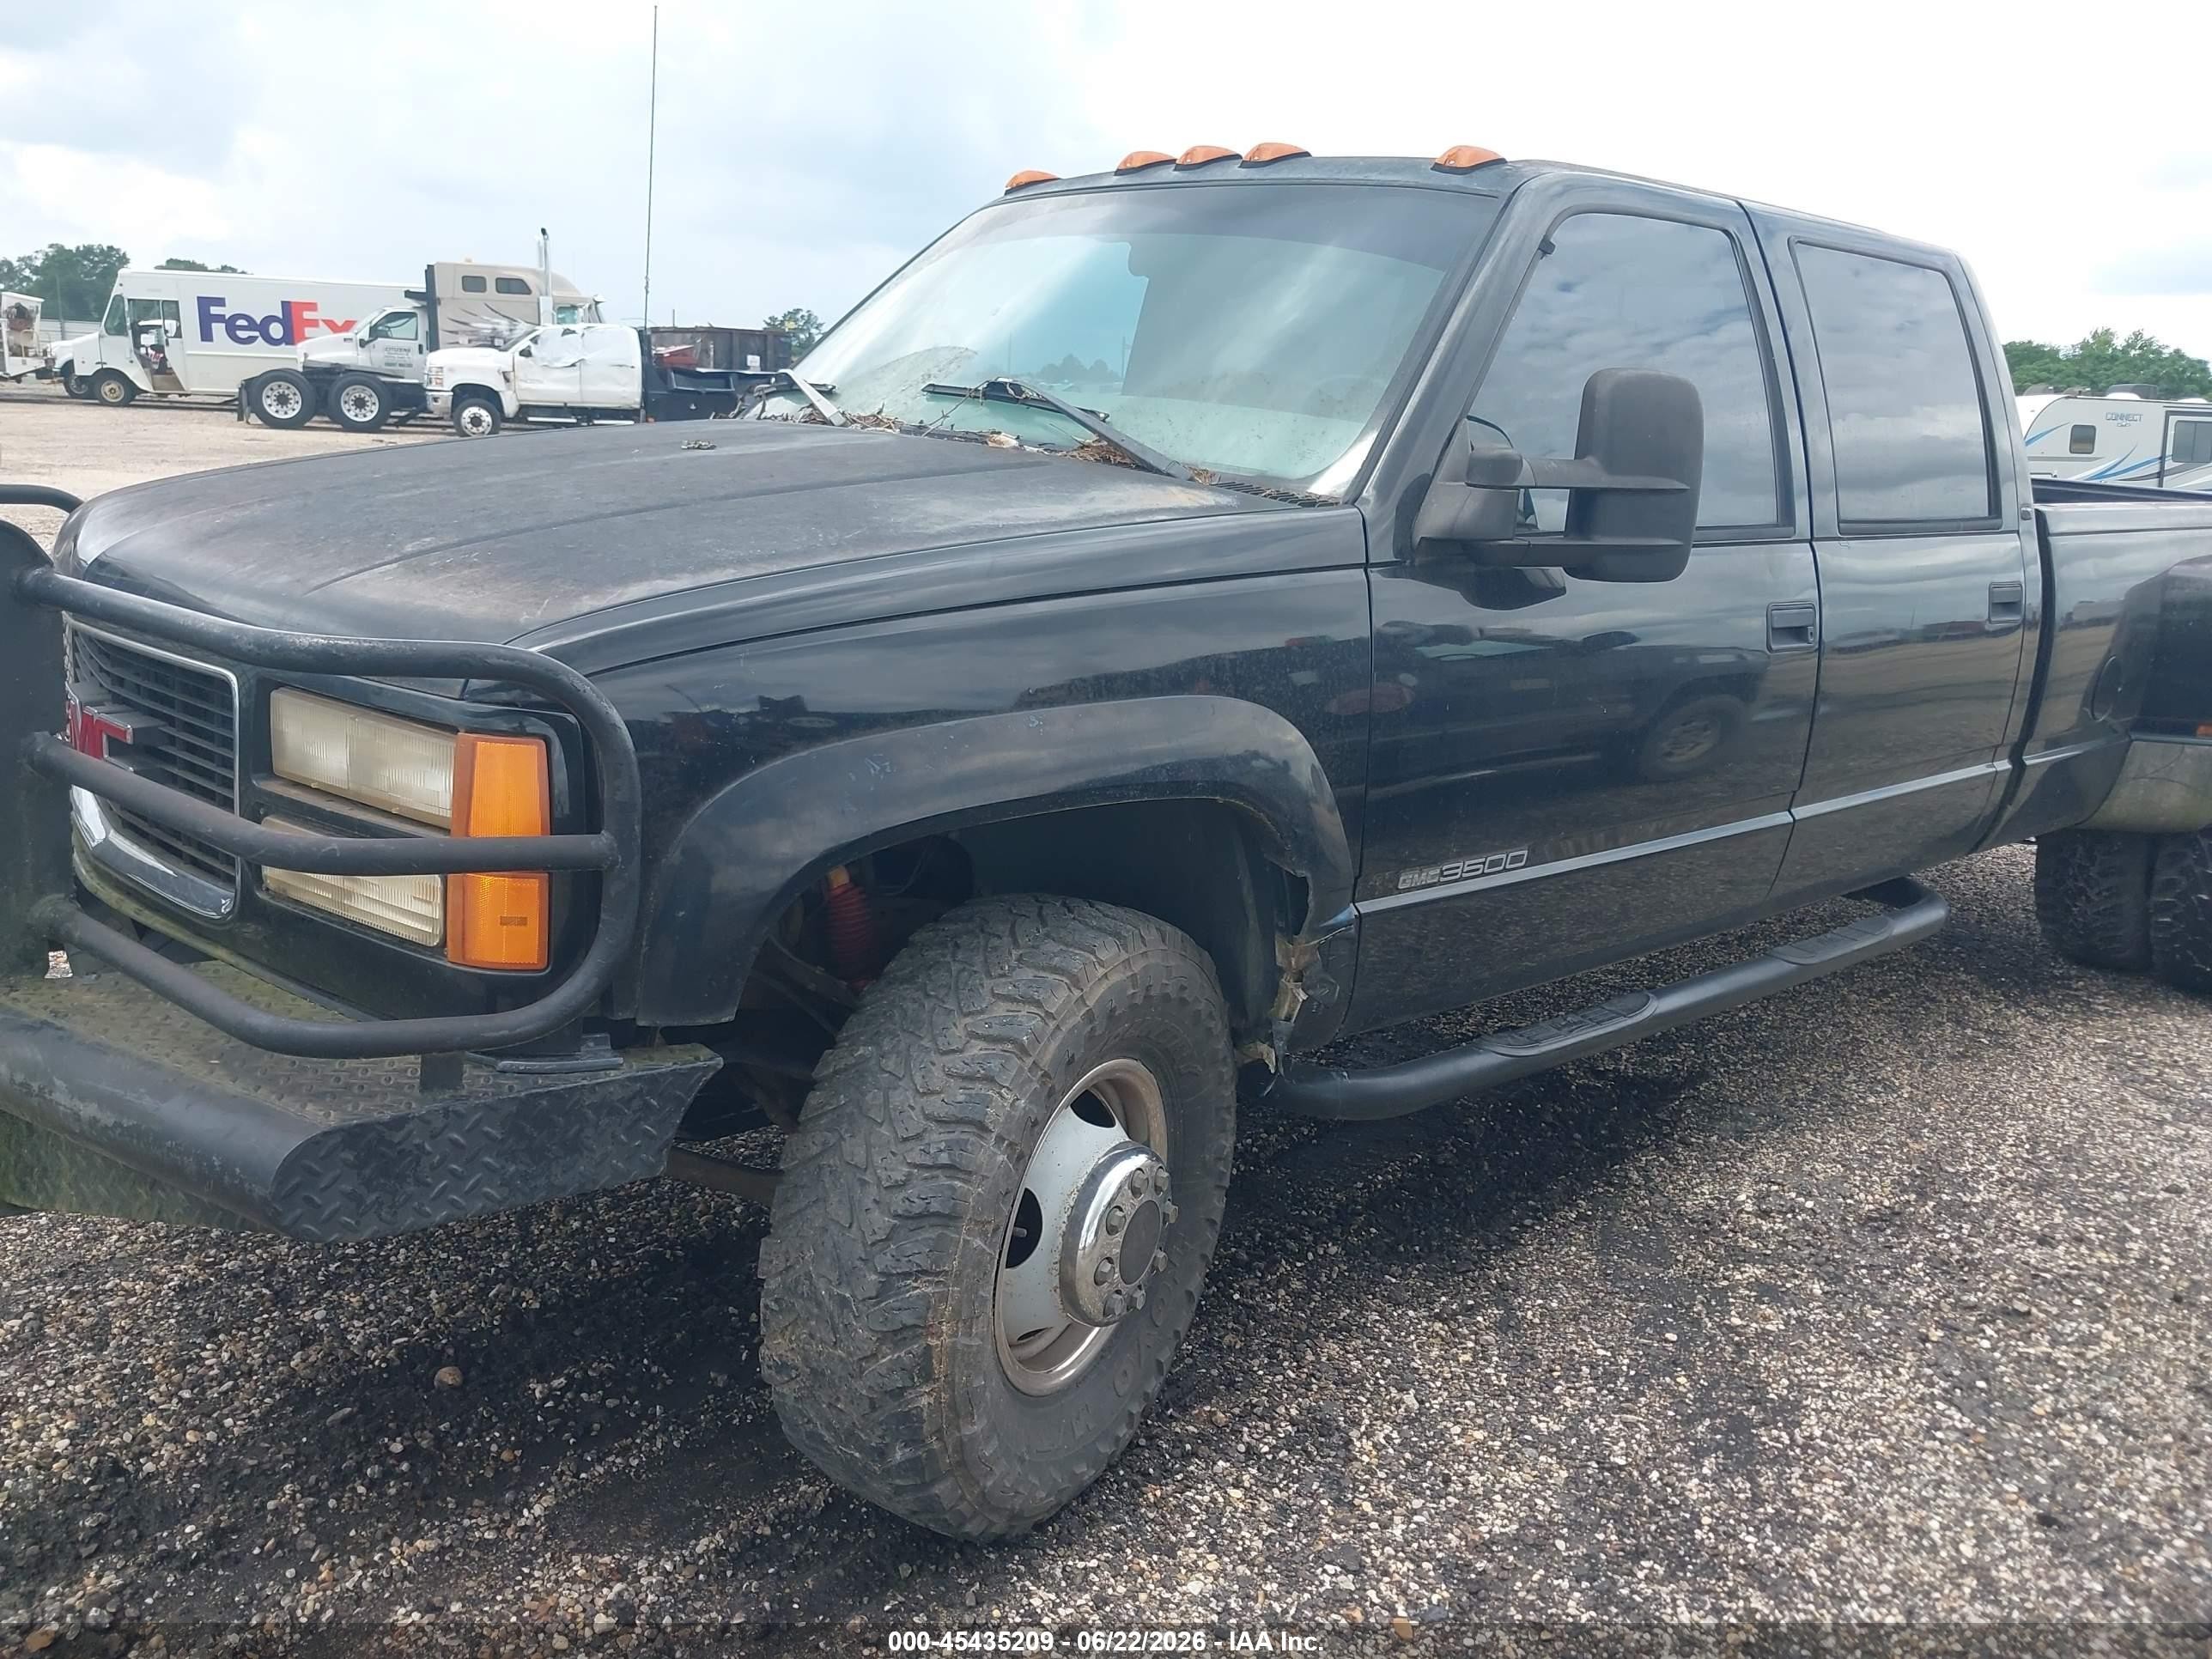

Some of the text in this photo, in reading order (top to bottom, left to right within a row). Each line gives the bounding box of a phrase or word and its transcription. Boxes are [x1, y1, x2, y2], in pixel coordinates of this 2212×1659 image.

[2106, 412, 2143, 422] CONNECT
[1398, 850, 1528, 889] GMC 3500
